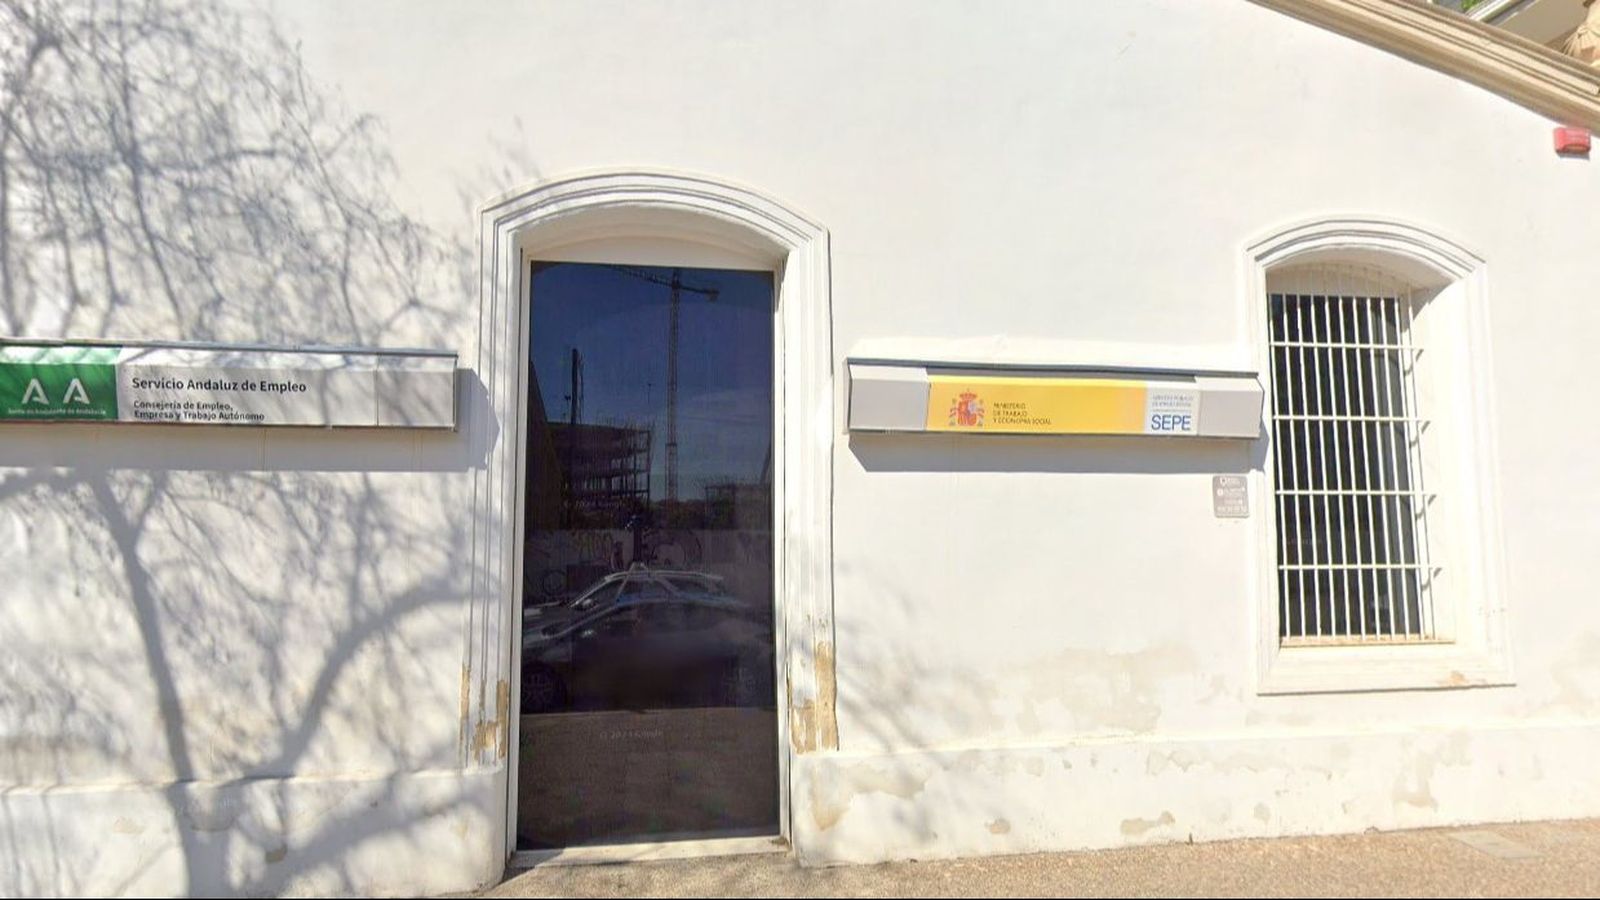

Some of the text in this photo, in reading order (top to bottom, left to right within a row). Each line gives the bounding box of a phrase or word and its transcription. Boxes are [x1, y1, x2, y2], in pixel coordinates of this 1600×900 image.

[132, 377, 307, 394] Servicio Andaluz de Empleo
[183, 401, 195, 410] de
[196, 402, 233, 412] Empleo,
[134, 410, 265, 421] Empresa y Trabajo Autónomo
[1151, 414, 1192, 431] SEPE
